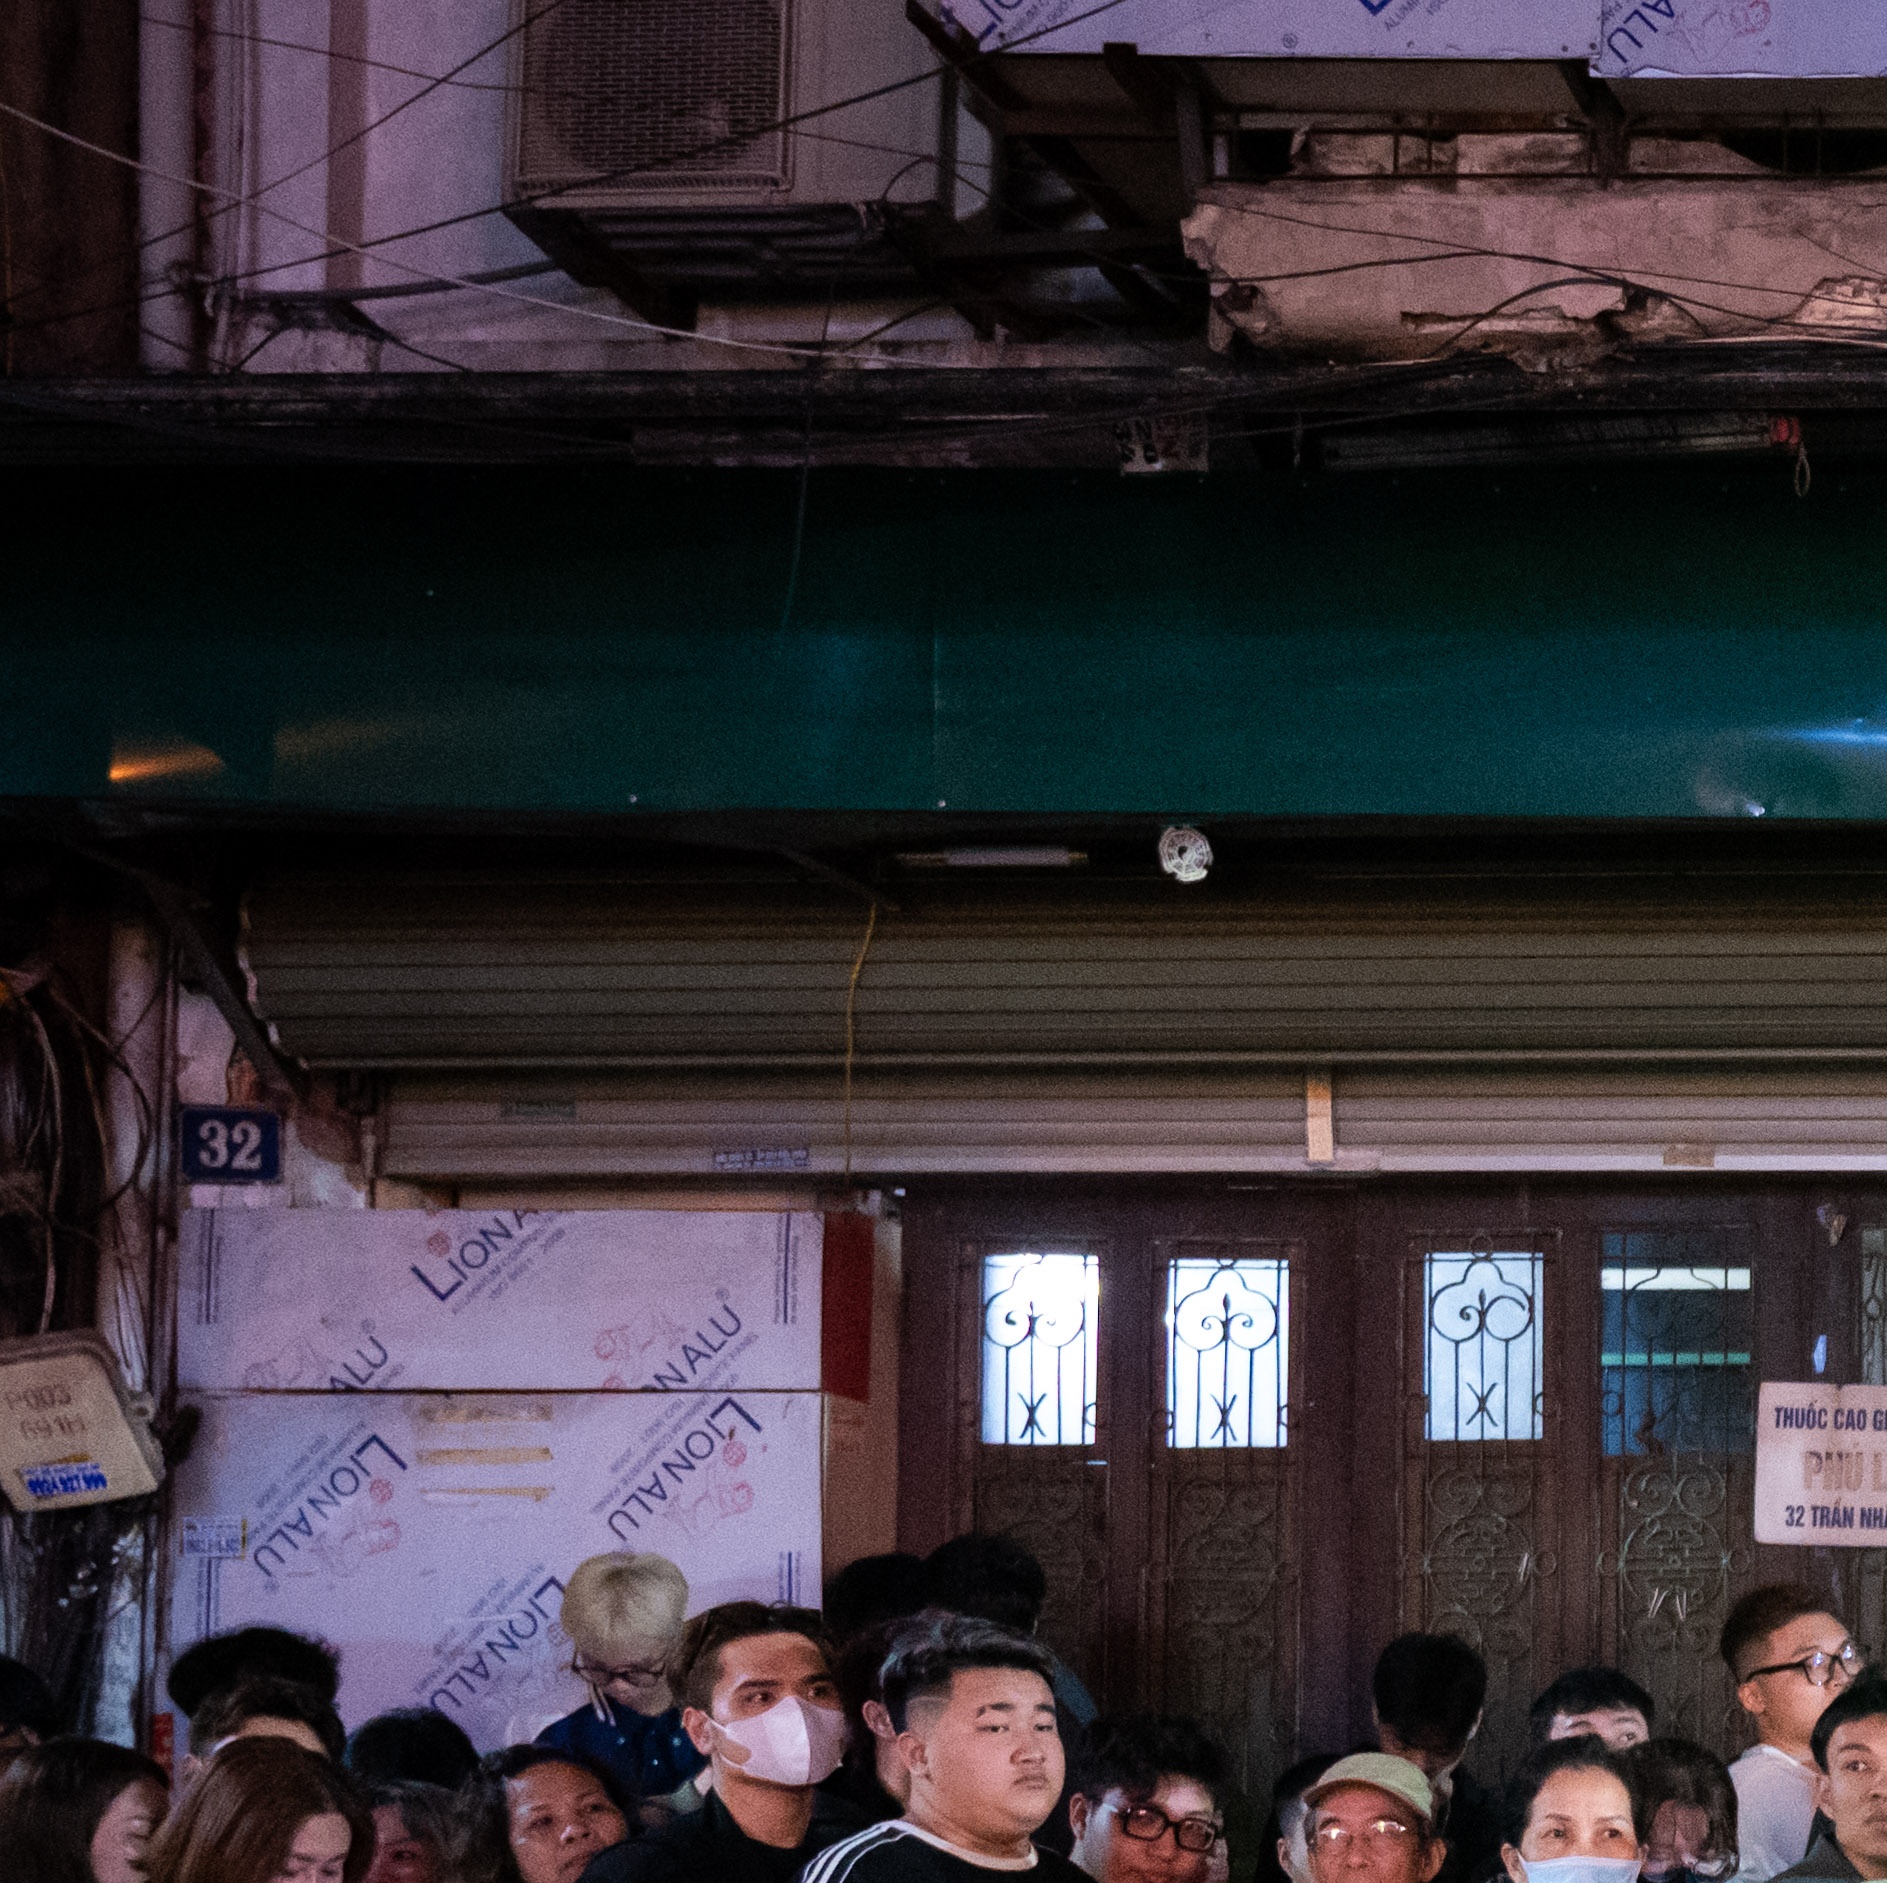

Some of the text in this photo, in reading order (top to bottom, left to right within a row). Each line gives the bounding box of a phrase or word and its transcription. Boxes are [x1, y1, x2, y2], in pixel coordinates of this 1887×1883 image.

[199, 1119, 262, 1170] 32
[1775, 1401, 1828, 1430] THUỐC
[1833, 1408, 1867, 1431] CAO
[607, 1397, 762, 1542] LIONALU
[253, 1433, 407, 1577] LIONALU
[1785, 1504, 1805, 1527] 32
